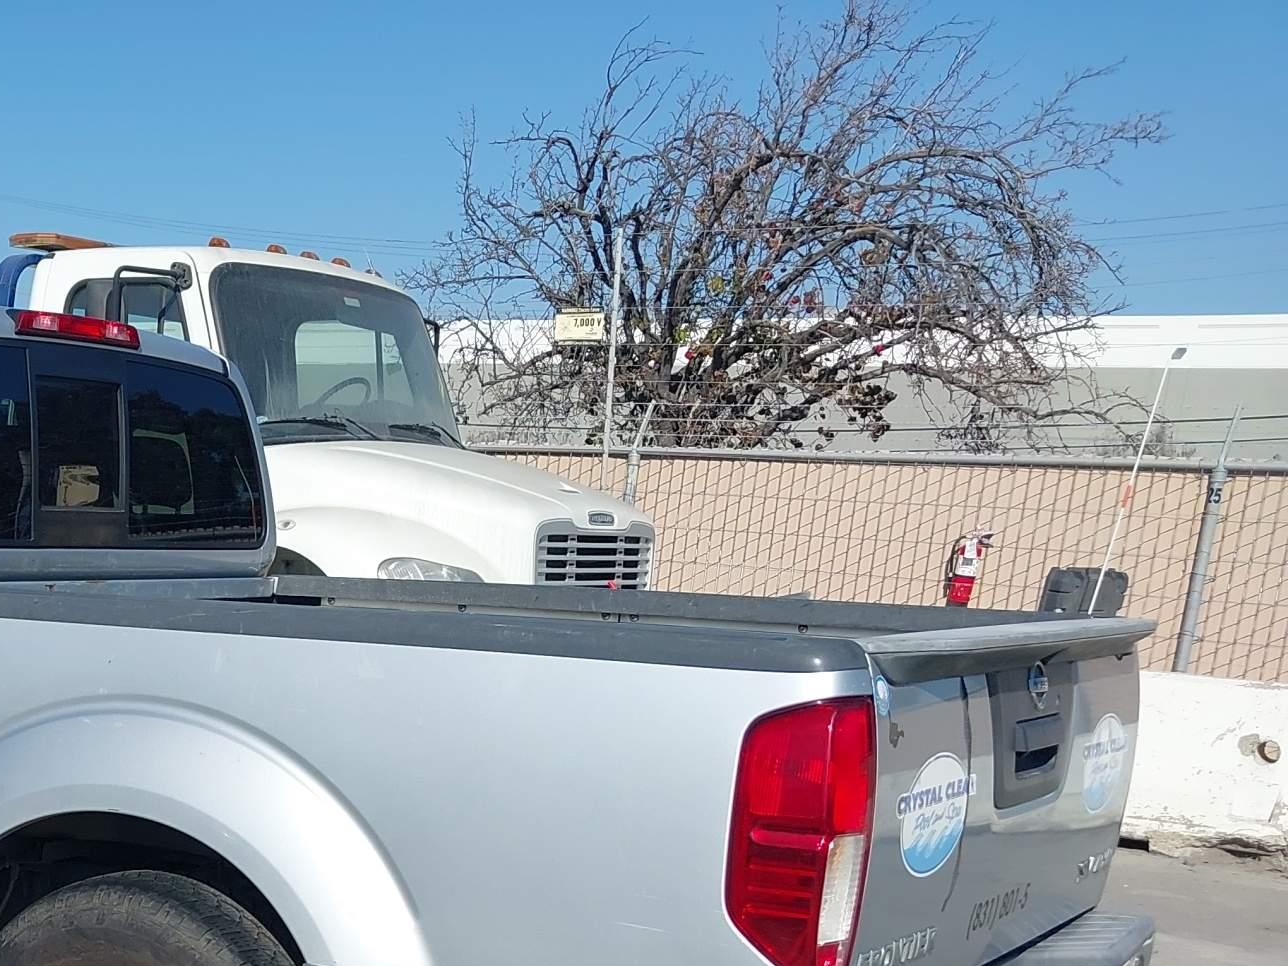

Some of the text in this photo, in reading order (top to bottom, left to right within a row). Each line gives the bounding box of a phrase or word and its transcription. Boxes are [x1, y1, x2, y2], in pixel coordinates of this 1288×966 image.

[573, 317, 602, 328] 7,000 V
[1208, 487, 1223, 504] 25
[897, 784, 943, 815] CRYSTAL
[966, 894, 1000, 941] (831)
